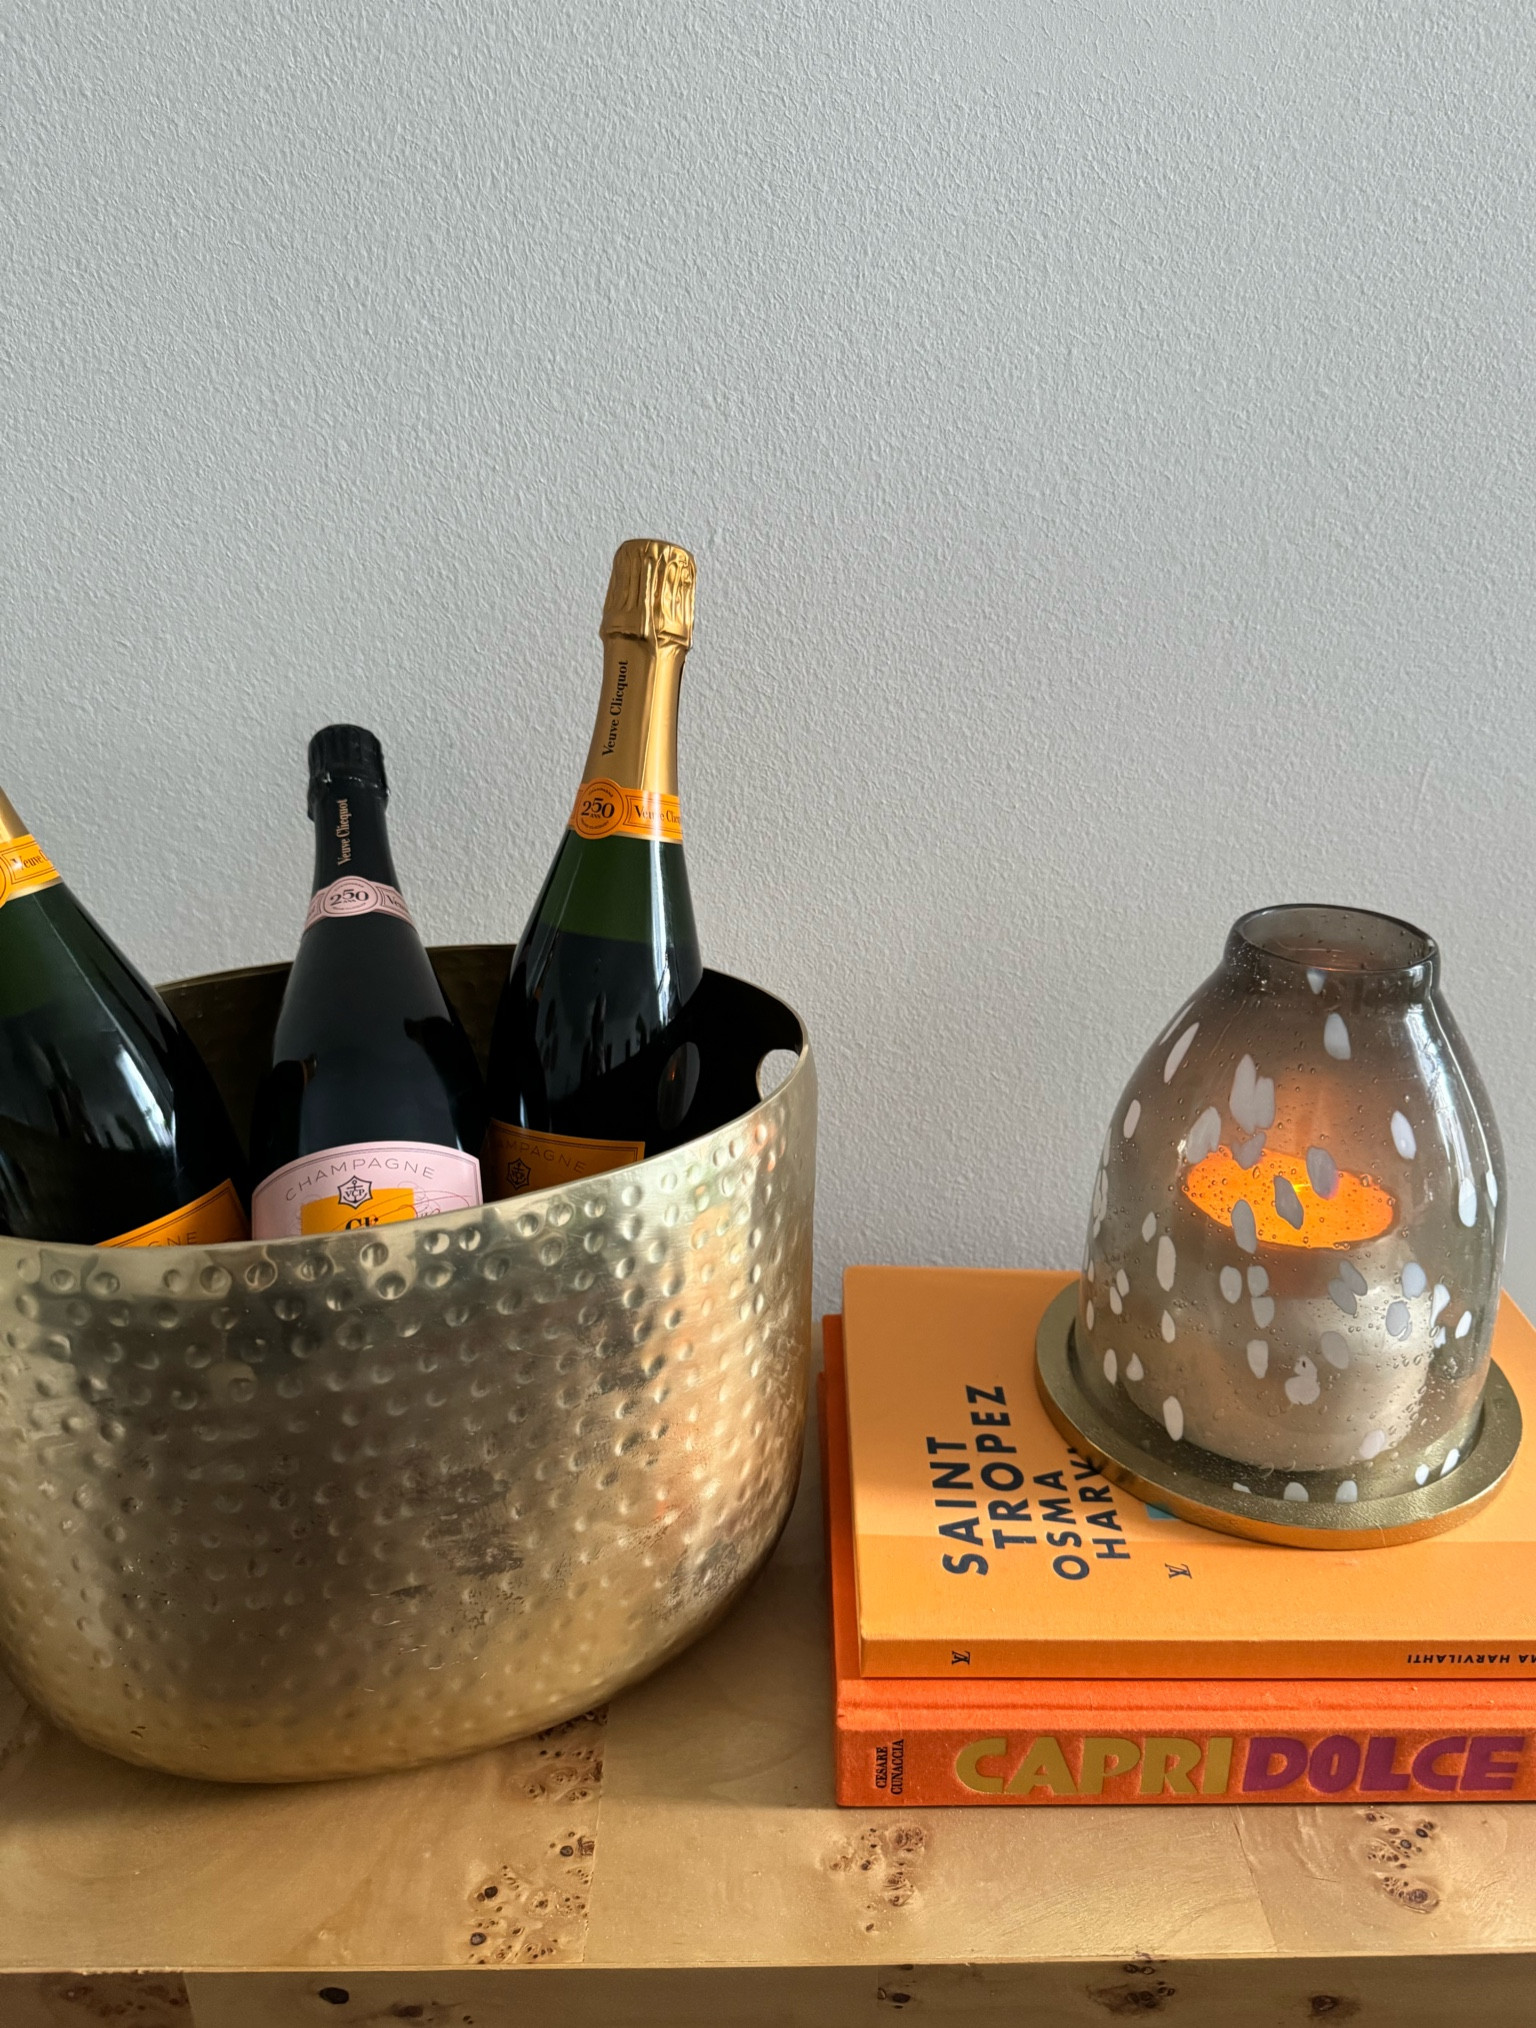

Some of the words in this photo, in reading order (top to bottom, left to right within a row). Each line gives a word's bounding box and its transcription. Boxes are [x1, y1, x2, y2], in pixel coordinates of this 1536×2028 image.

[609, 659, 629, 716] Clicquot
[602, 718, 620, 756] Veuve
[336, 798, 352, 838] Clicquot
[581, 798, 615, 819] 250
[634, 805, 665, 822] Veue
[337, 838, 351, 866] Veuve
[330, 888, 369, 906] 250
[286, 1157, 436, 1201] CHAMPAGNE
[965, 1384, 1037, 1549] TROPEZ
[926, 1436, 989, 1576] SAINT
[1033, 1470, 1090, 1581] OSMA
[1407, 1654, 1511, 1664] HARVILAHTI
[875, 1745, 889, 1789] CESARE
[890, 1738, 905, 1795] CUNACCIA
[954, 1736, 1234, 1795] CAPRI
[1242, 1734, 1526, 1794] DOLCE
